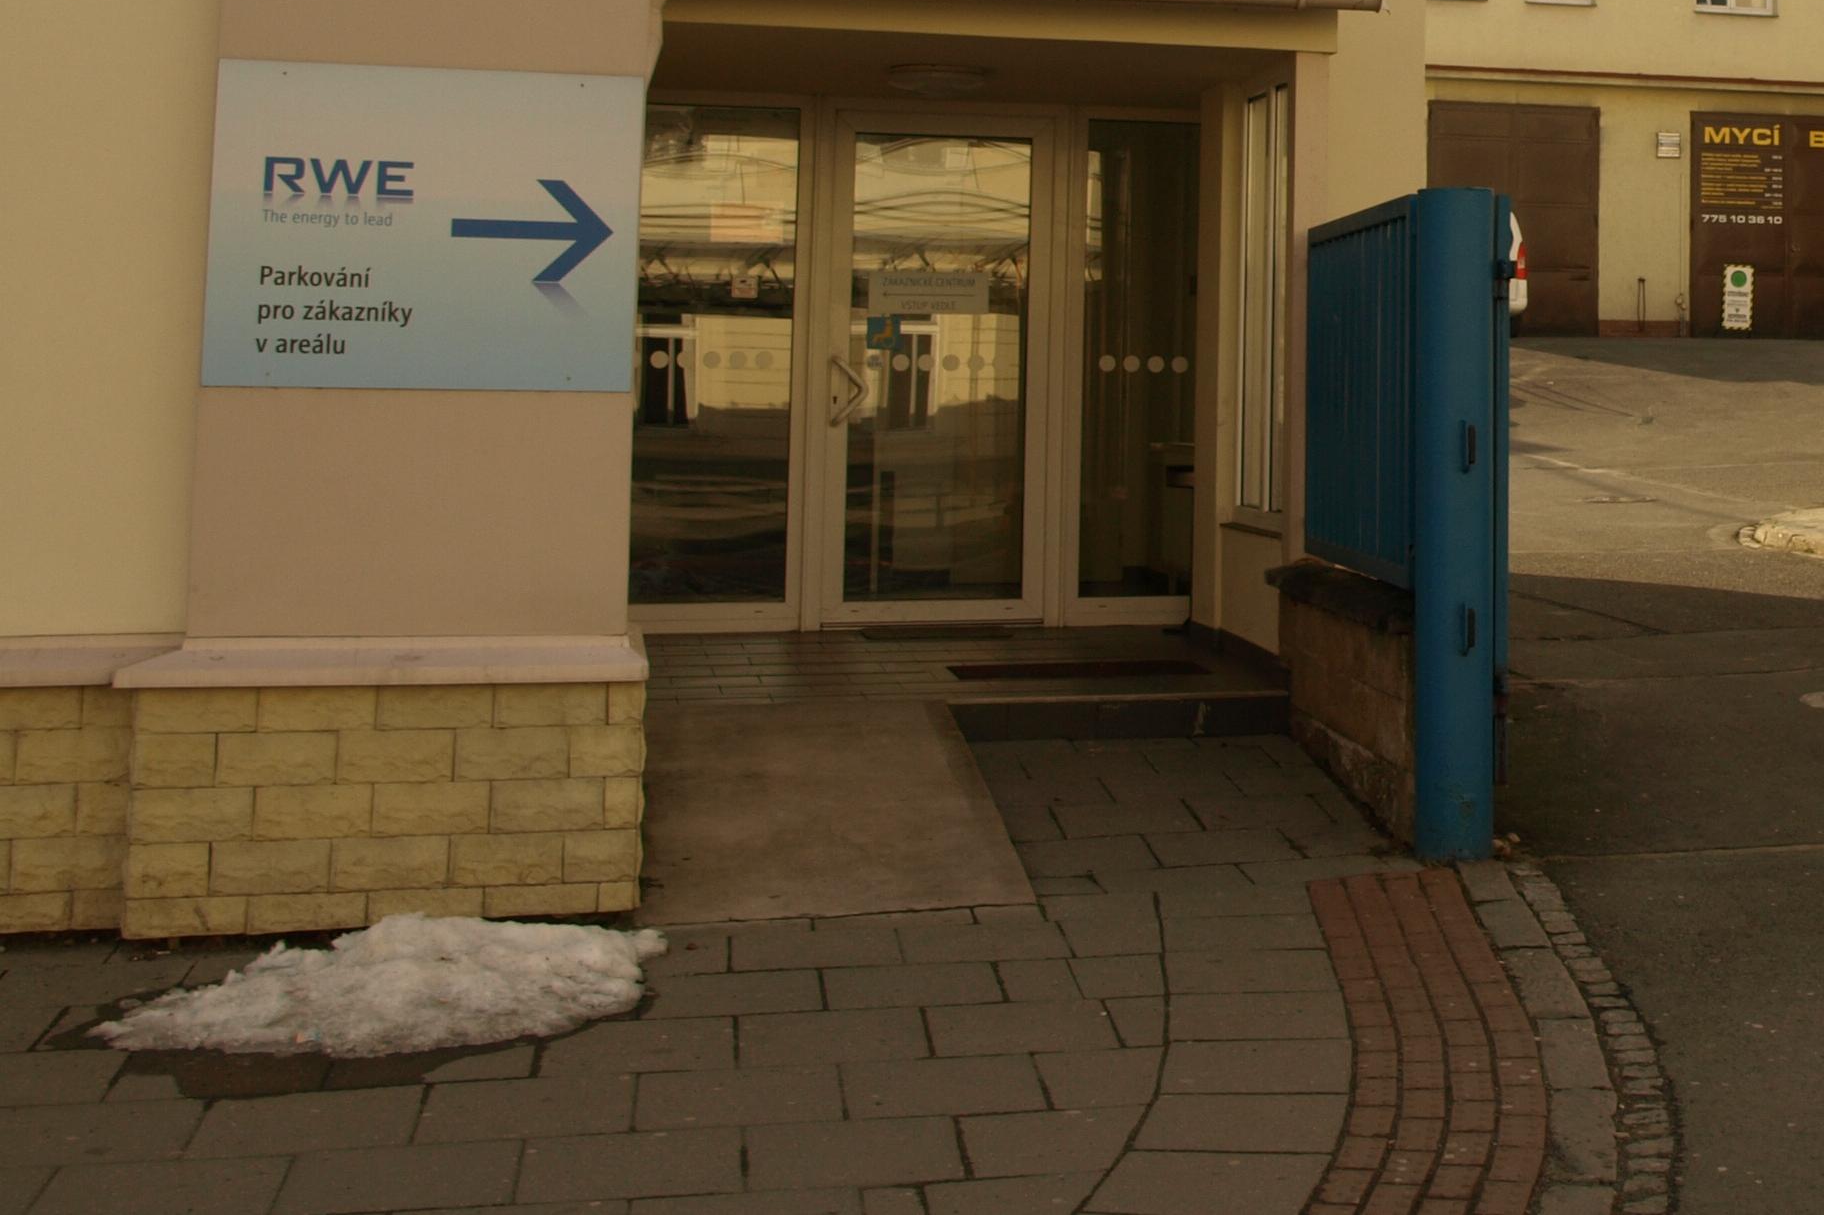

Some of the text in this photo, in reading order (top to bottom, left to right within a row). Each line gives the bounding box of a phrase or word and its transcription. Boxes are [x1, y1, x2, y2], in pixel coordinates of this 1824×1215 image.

[1704, 124, 1781, 146] MYCÍ
[264, 156, 414, 197] RWE
[262, 209, 393, 229] The energy to lead
[1701, 213, 1727, 224] 775
[1729, 214, 1746, 224] 10
[1766, 215, 1783, 225] 10
[259, 265, 372, 289] Parkování
[257, 299, 413, 328] pro zákazníky
[256, 333, 346, 355] v areálu
